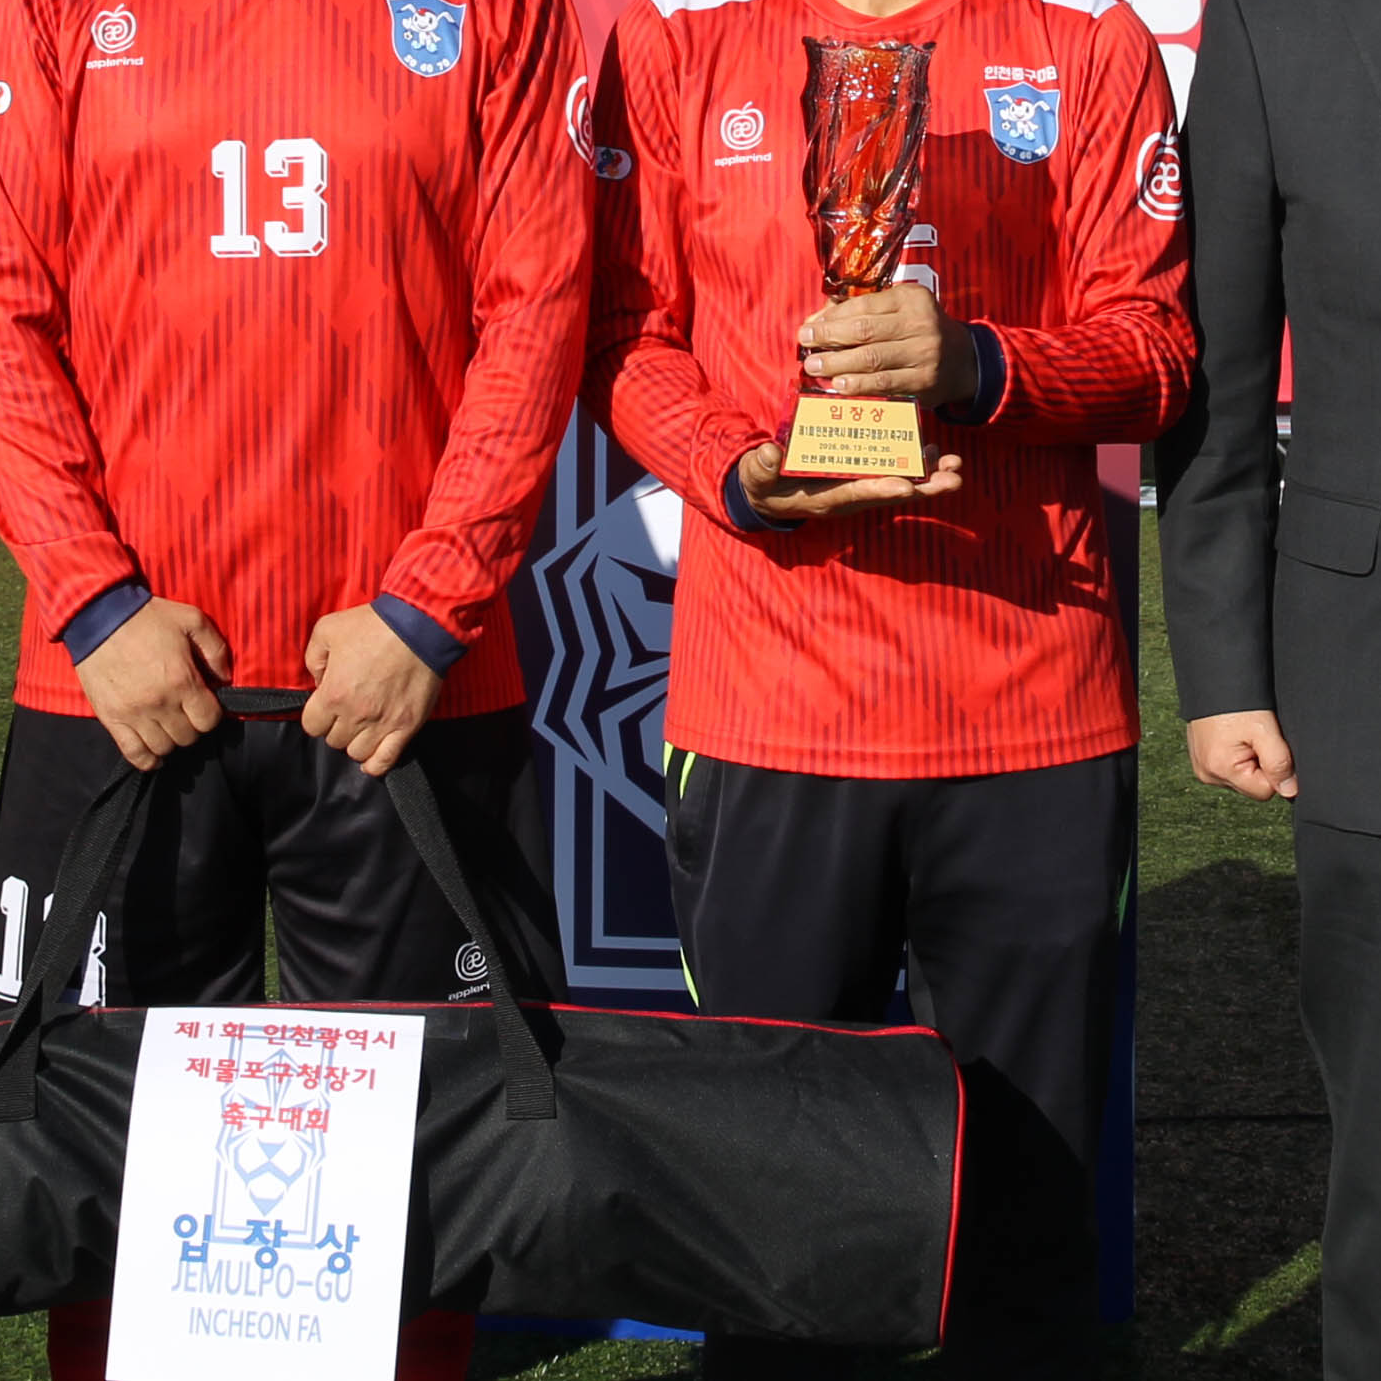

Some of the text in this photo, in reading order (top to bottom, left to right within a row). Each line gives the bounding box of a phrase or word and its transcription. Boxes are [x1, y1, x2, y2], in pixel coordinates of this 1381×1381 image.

[210, 138, 328, 257] 13
[174, 1021, 396, 1050] 제1회 인천광역시
[185, 1057, 376, 1091] 제물포구청장기
[222, 1102, 330, 1133] 축구대회
[171, 1258, 354, 1303] JEMULPO-GU
[189, 1306, 323, 1343] INCHEON FA
